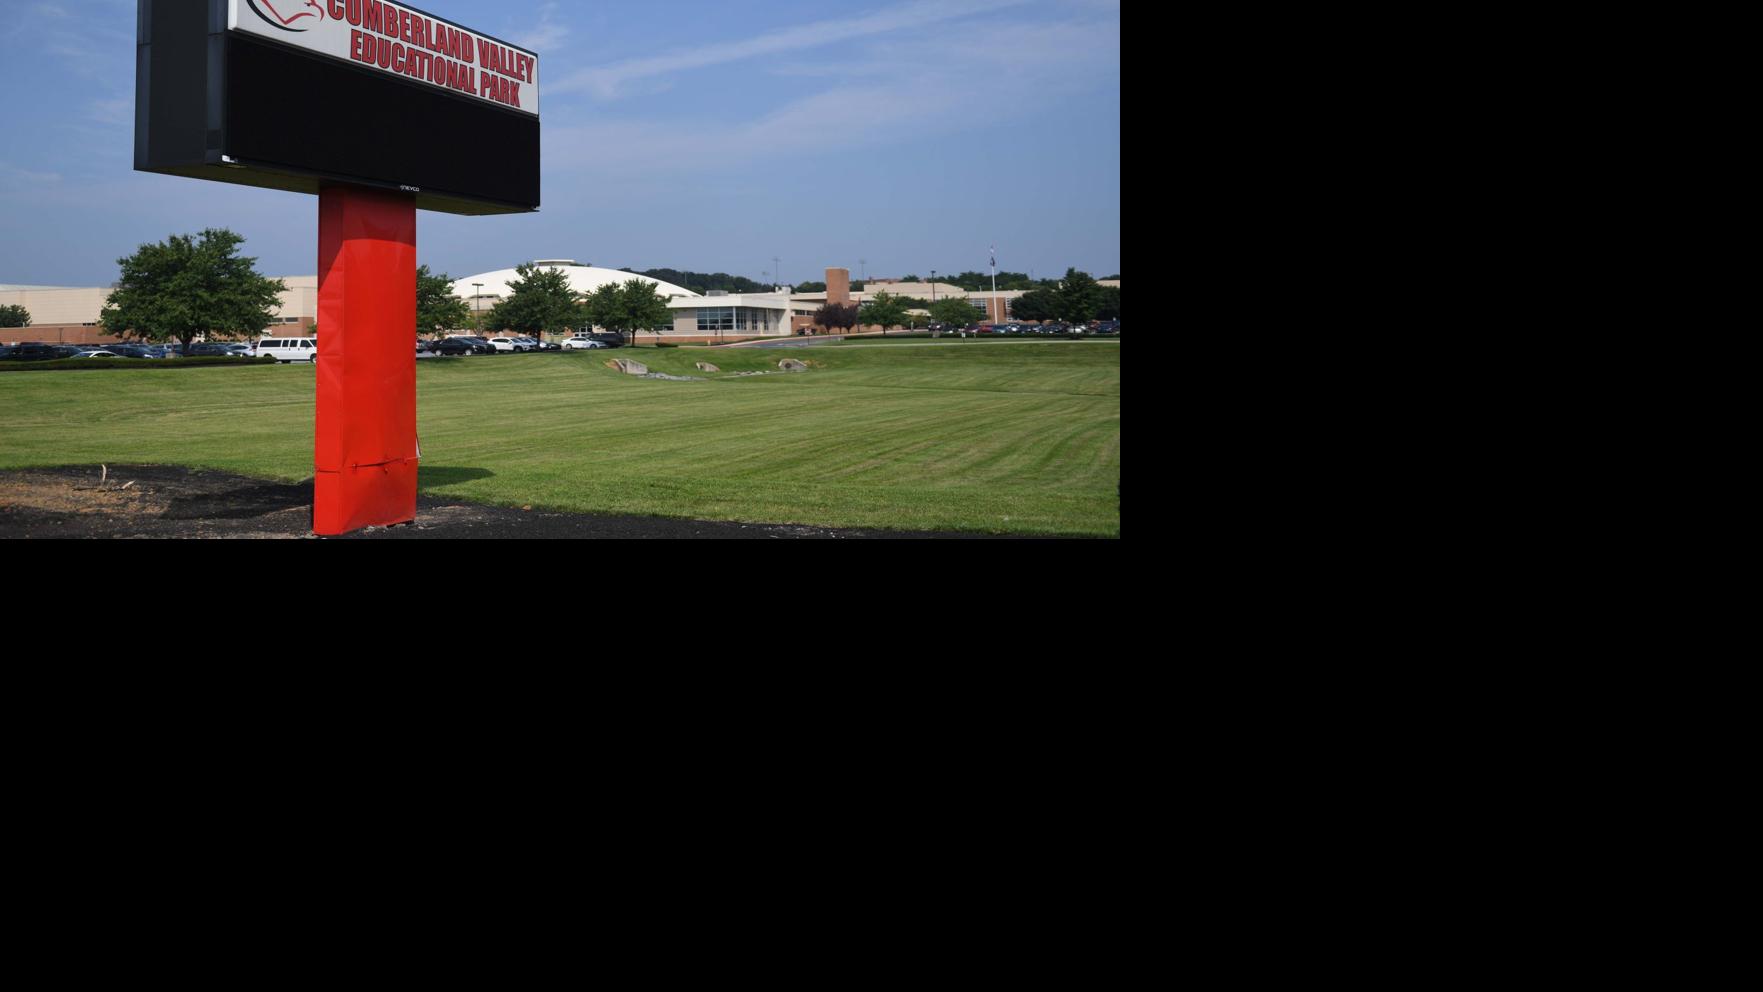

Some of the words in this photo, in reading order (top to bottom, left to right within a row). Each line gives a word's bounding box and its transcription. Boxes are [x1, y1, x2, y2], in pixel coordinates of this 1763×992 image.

[327, 0, 474, 64] CUMBERLAND
[477, 39, 534, 84] VALLEY
[350, 28, 477, 95] EDUCATIONAL
[480, 70, 521, 108] PARK
